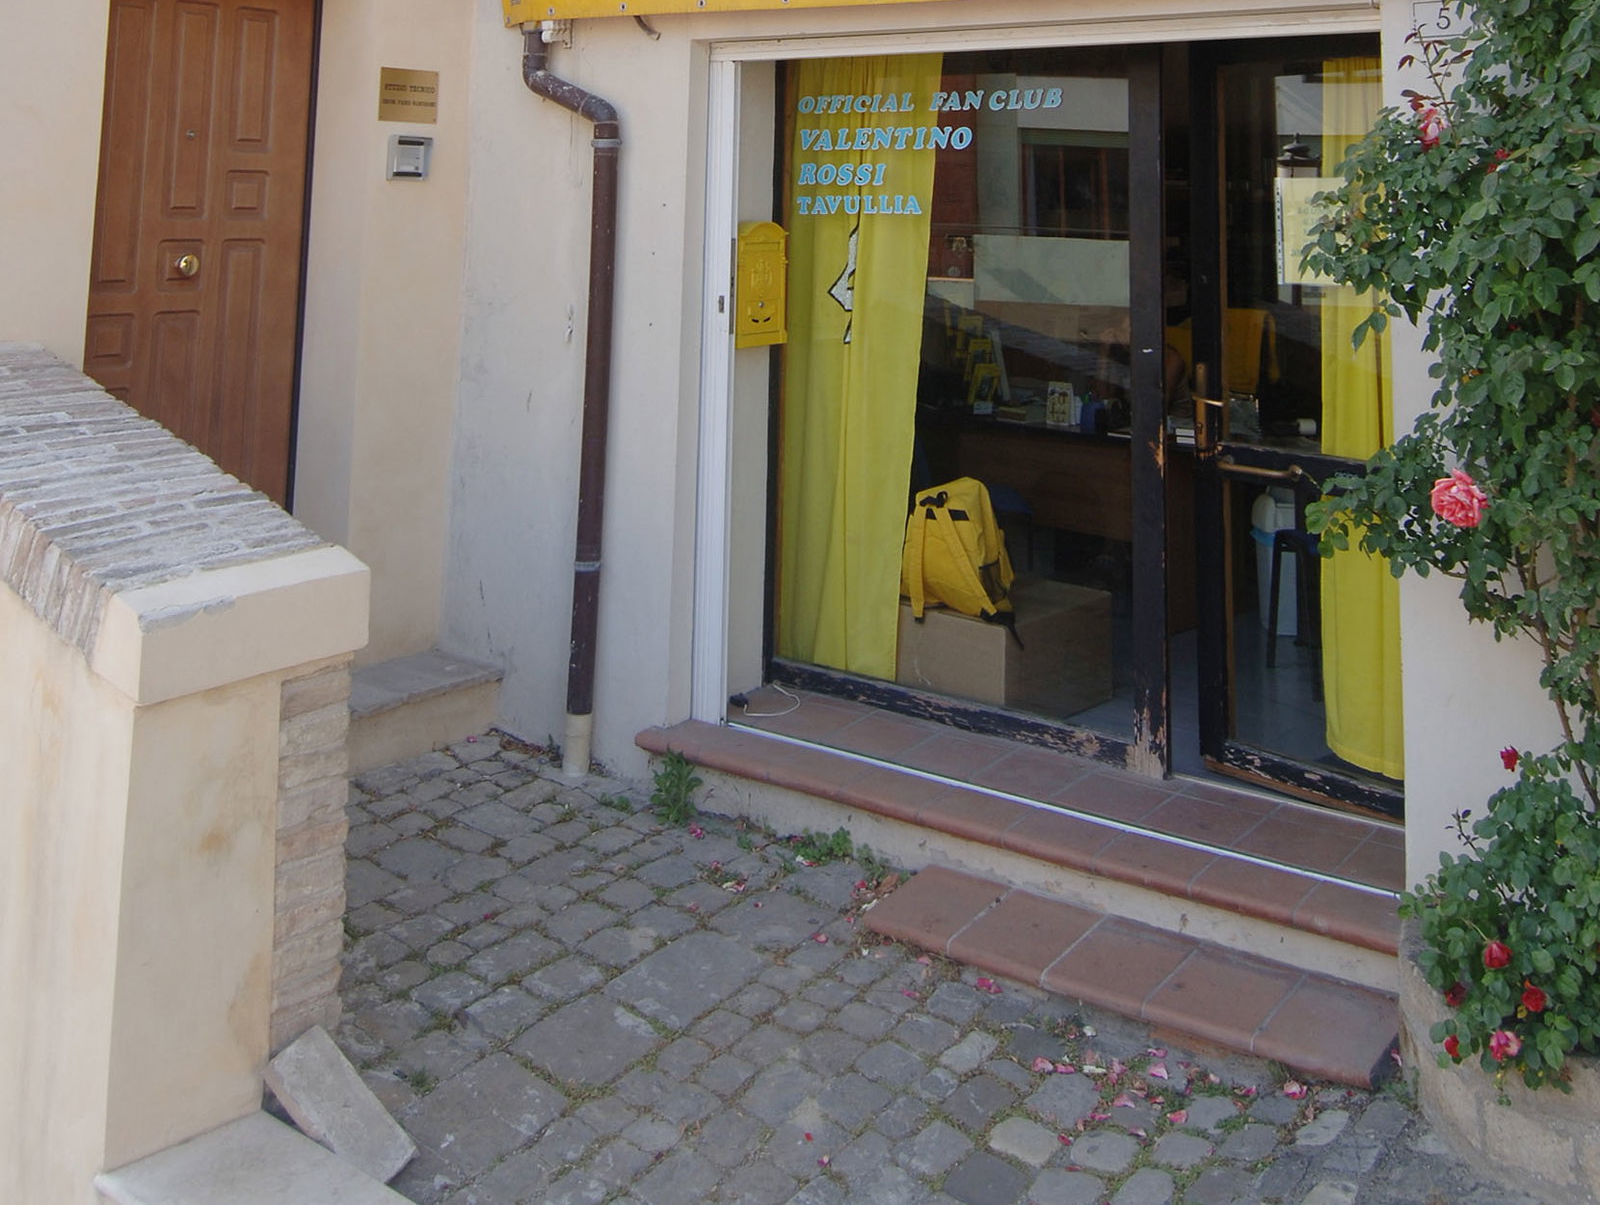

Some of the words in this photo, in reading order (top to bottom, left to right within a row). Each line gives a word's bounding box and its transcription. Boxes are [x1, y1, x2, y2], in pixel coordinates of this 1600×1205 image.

[1436, 7, 1451, 30] 5
[797, 92, 915, 114] OFFICIAL
[929, 90, 985, 112] FAN
[988, 87, 1063, 111] CLUB
[799, 126, 973, 151] VALENTINO
[797, 162, 887, 186] ROSSI
[796, 195, 922, 215] TAVULLIA
